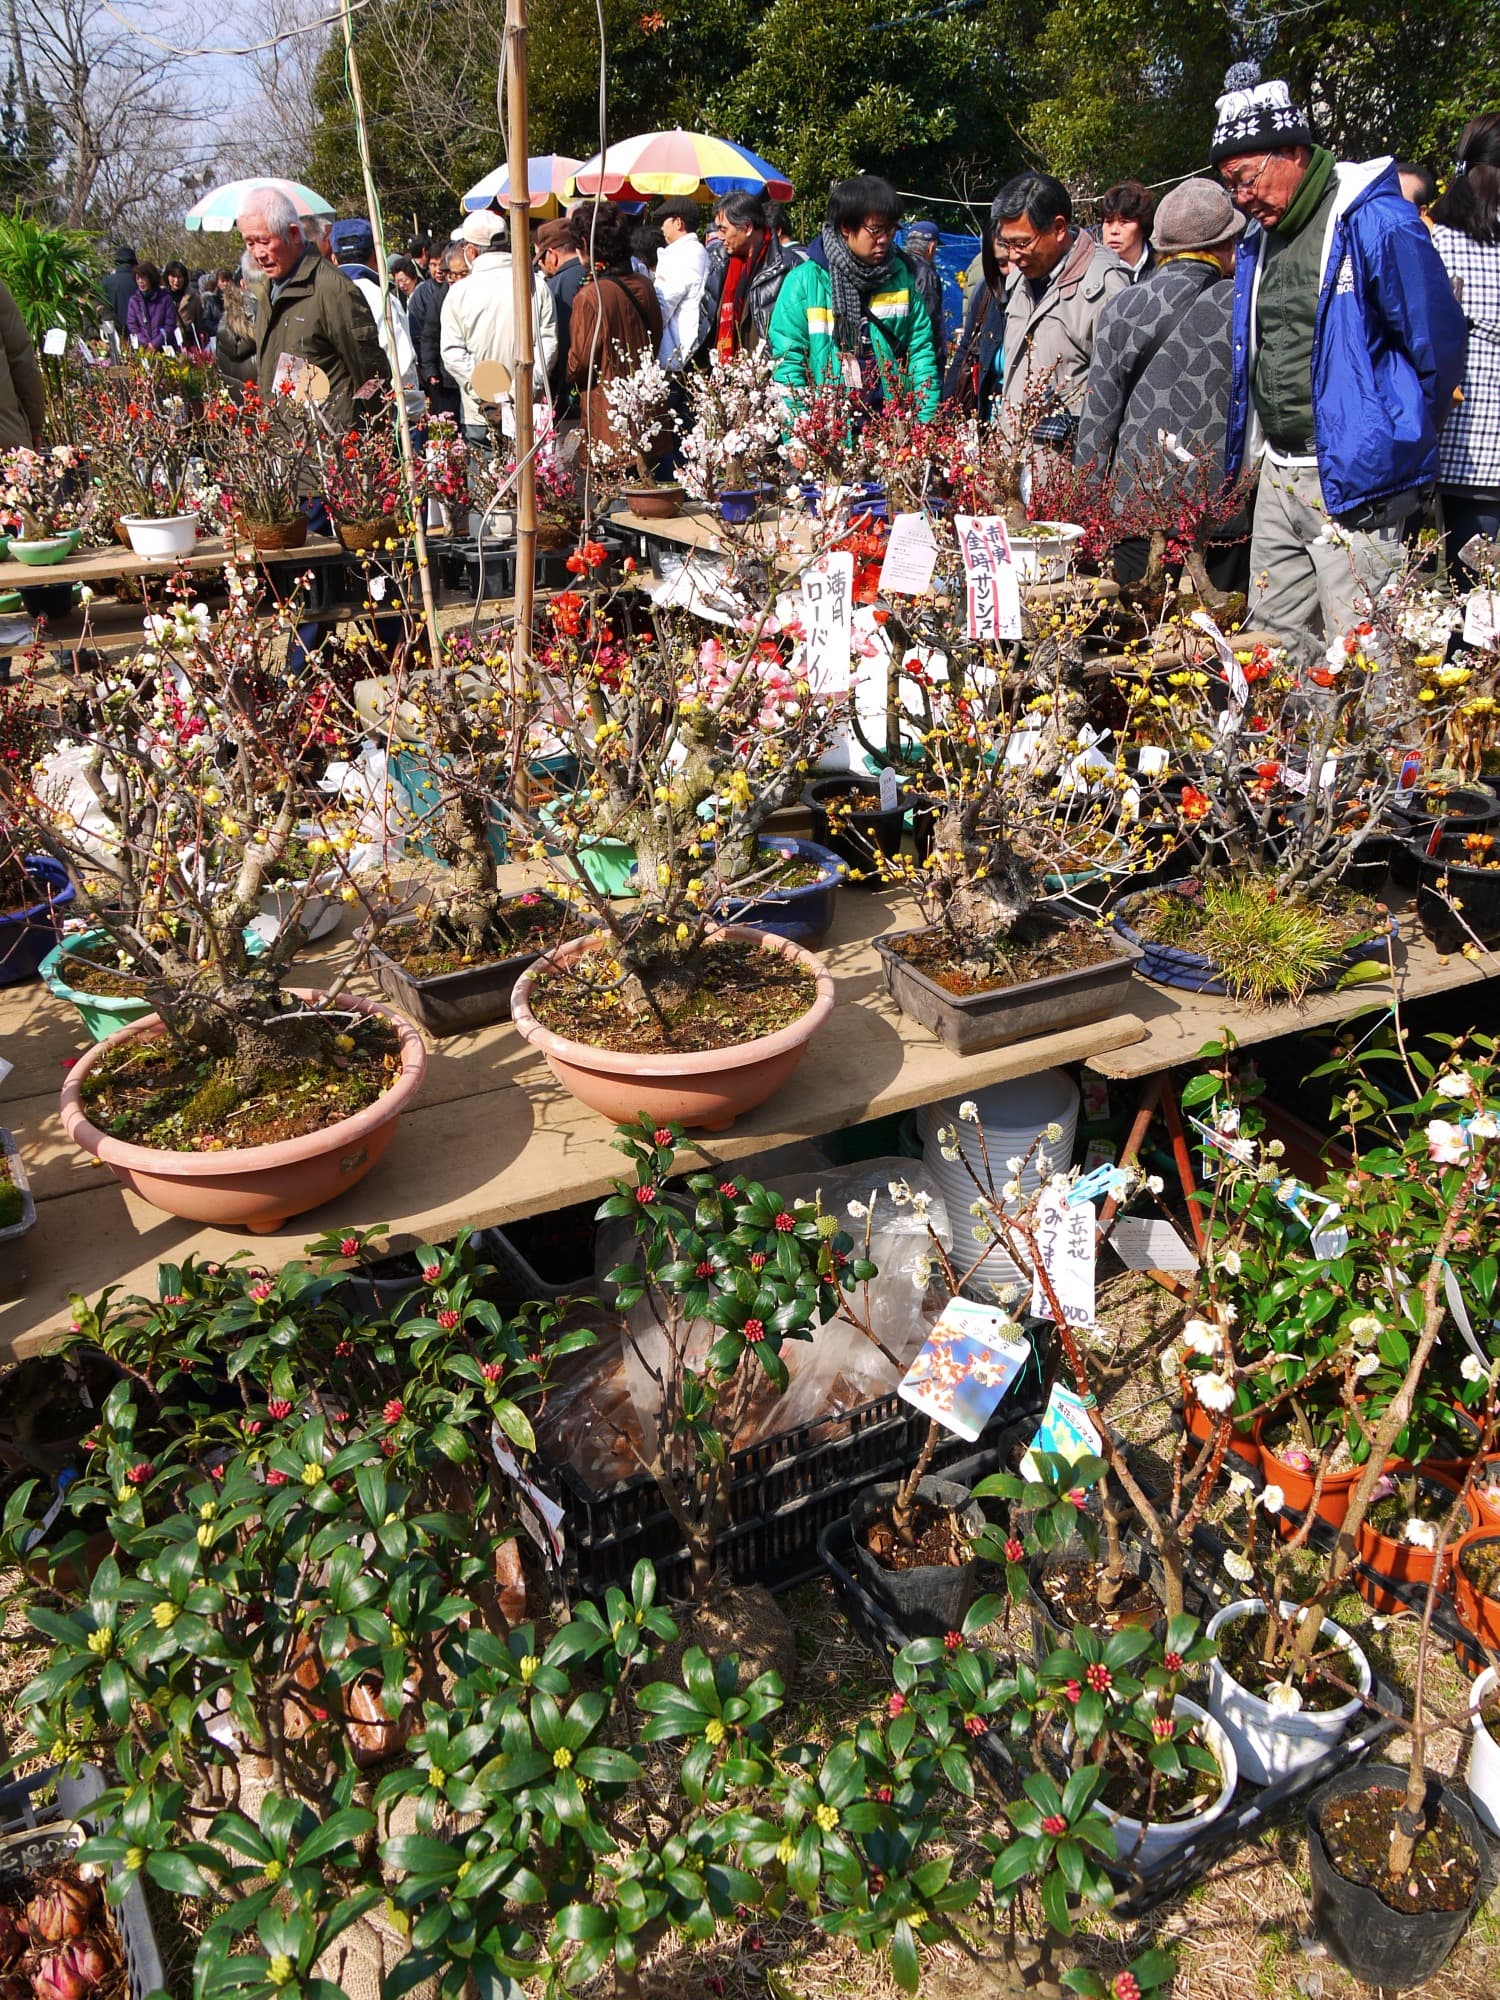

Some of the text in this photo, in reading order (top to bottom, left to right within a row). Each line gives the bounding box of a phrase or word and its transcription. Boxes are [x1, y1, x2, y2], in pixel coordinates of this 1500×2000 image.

[807, 582, 829, 688] ローバイ
[826, 568, 847, 628] 満月
